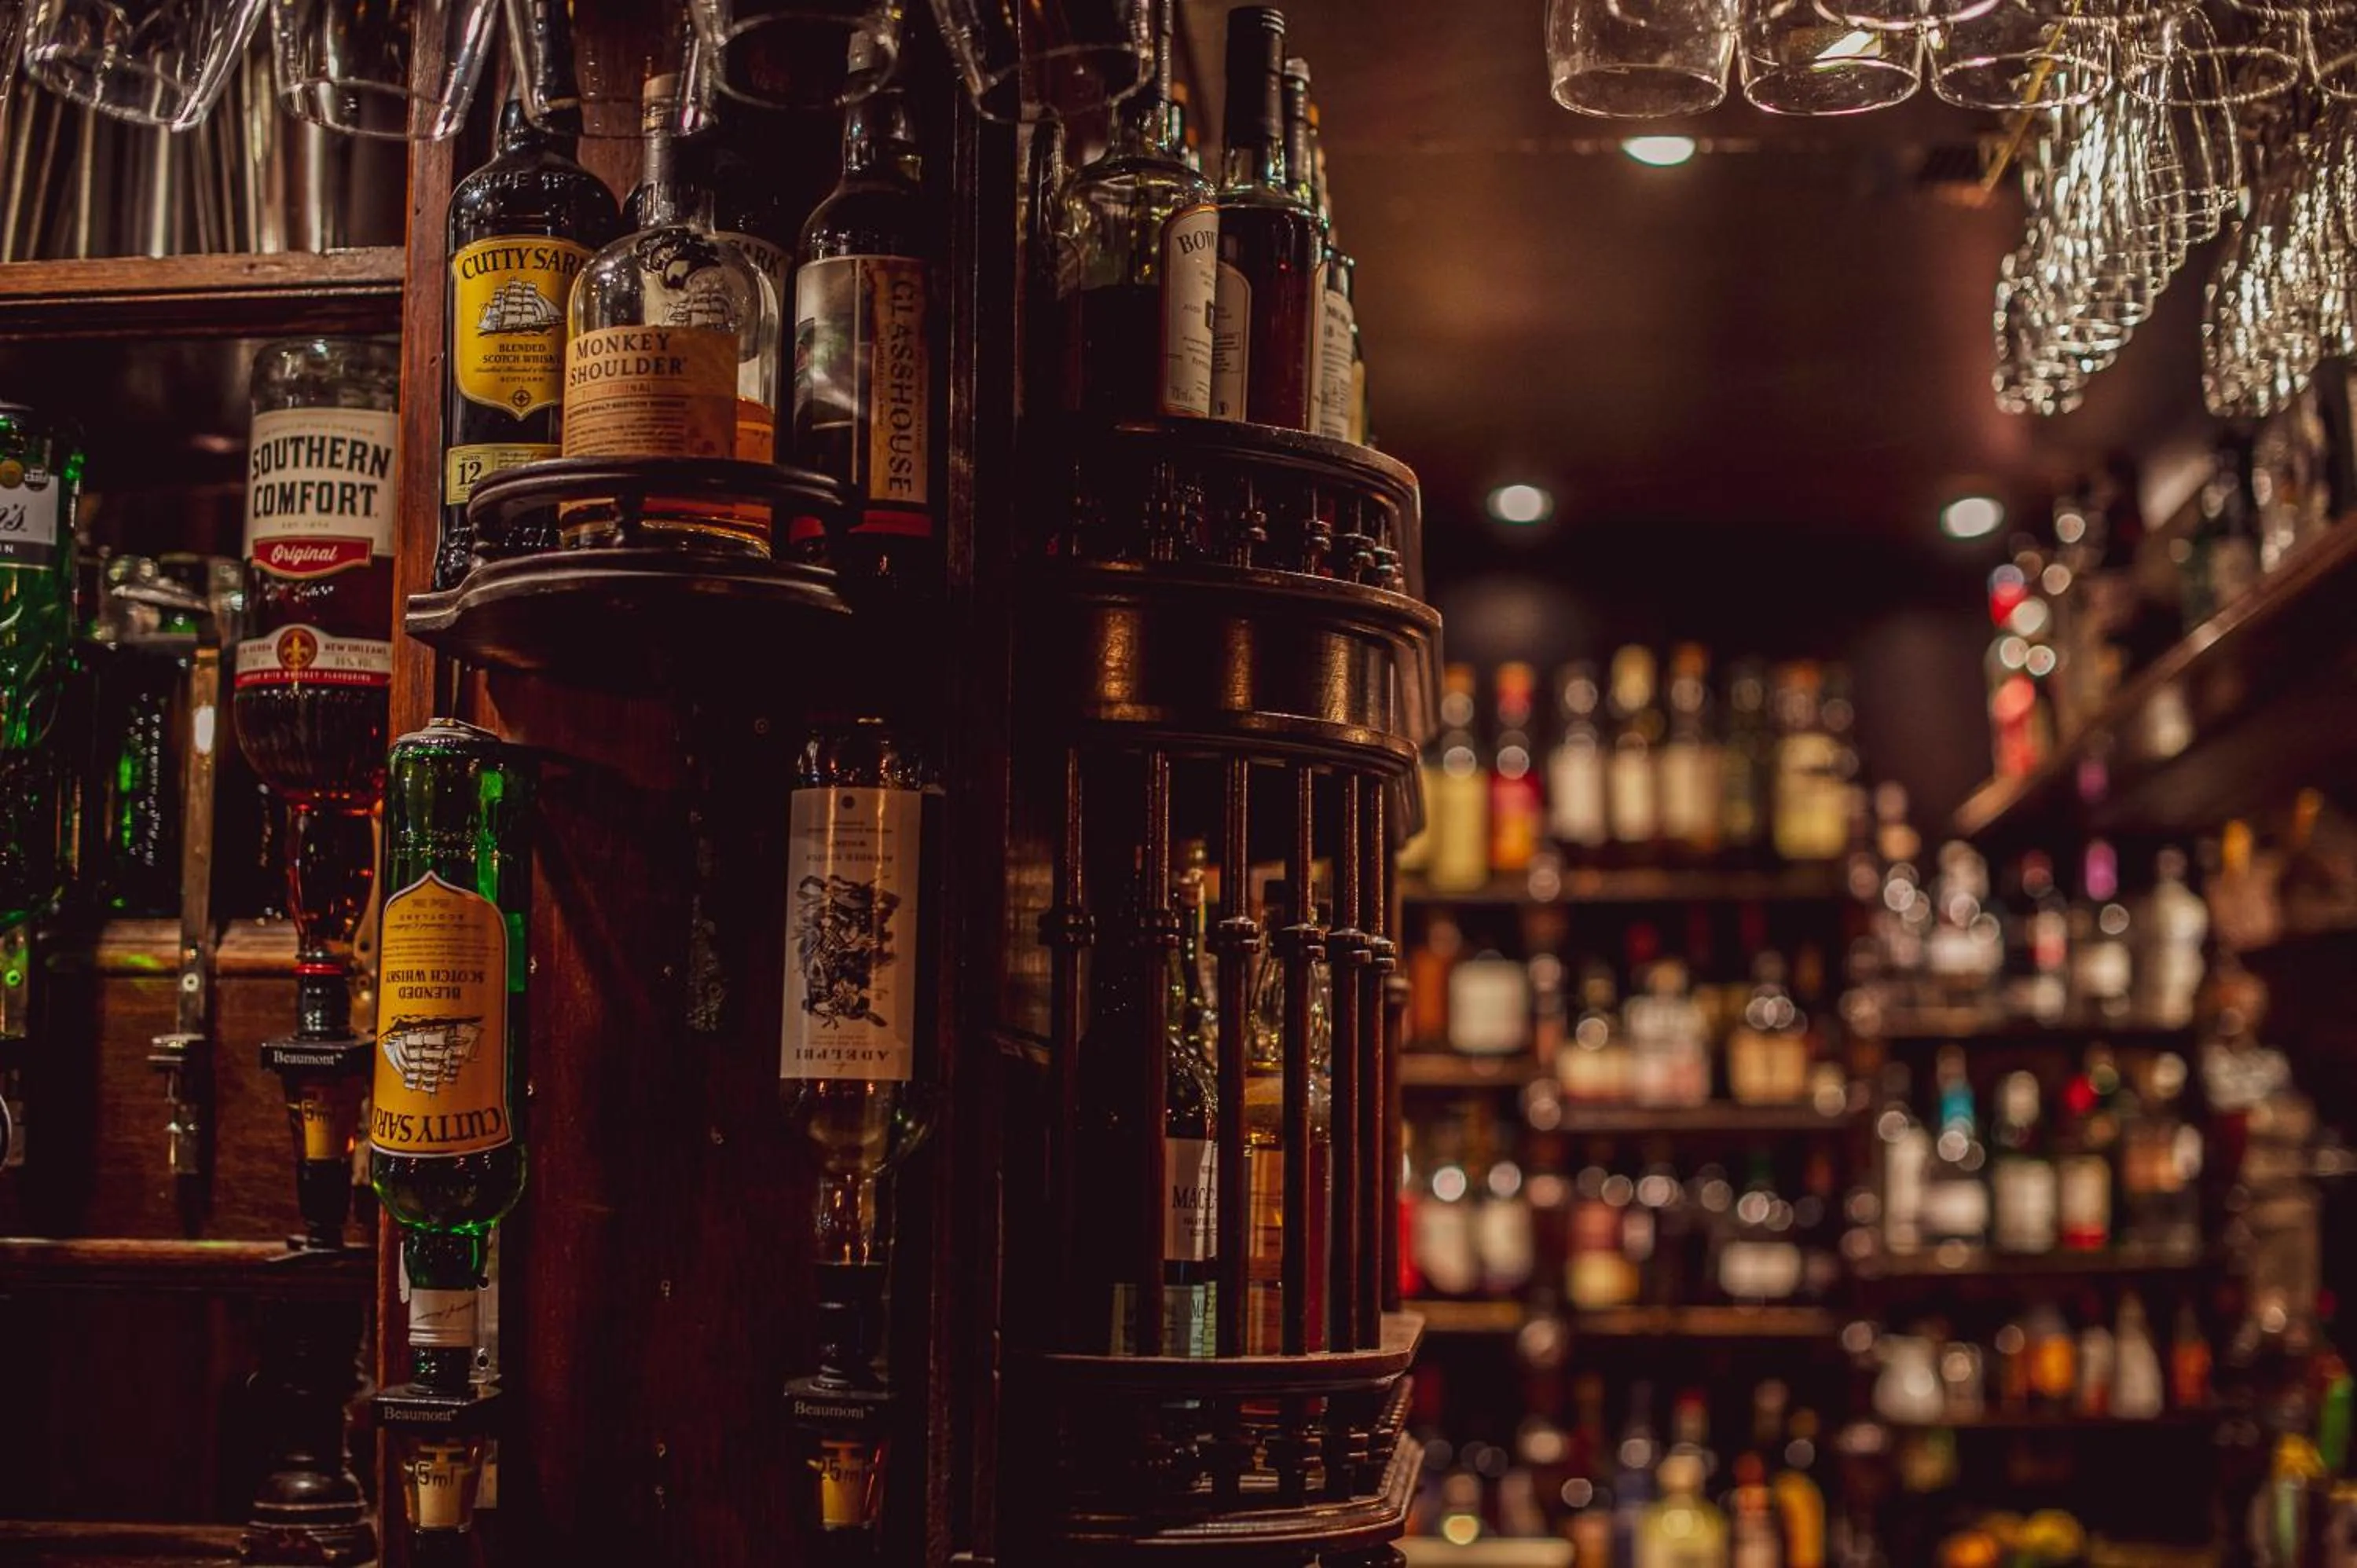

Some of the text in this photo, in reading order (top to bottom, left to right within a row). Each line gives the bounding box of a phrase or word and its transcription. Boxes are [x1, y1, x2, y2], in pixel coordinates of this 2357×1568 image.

[461, 247, 533, 279] CUTTY
[498, 343, 546, 353] BLENDED
[576, 333, 670, 361] MONKEY
[482, 354, 519, 364] SCOTCH
[570, 357, 683, 387] SHOULDER
[888, 280, 915, 493] GLASSHOUSE
[252, 435, 392, 481] SOUTHERN
[458, 461, 482, 485] 12
[254, 480, 379, 519] COMFORT
[270, 543, 338, 566] Original
[430, 969, 485, 983] SCOTCH
[398, 986, 461, 1000] BLENDED
[273, 1050, 335, 1065] Beaumont
[796, 1049, 889, 1061] ADELPHI
[372, 1107, 502, 1143] CUTTY SAR
[383, 1406, 453, 1422] Beaumont
[794, 1400, 865, 1420] Beaumont
